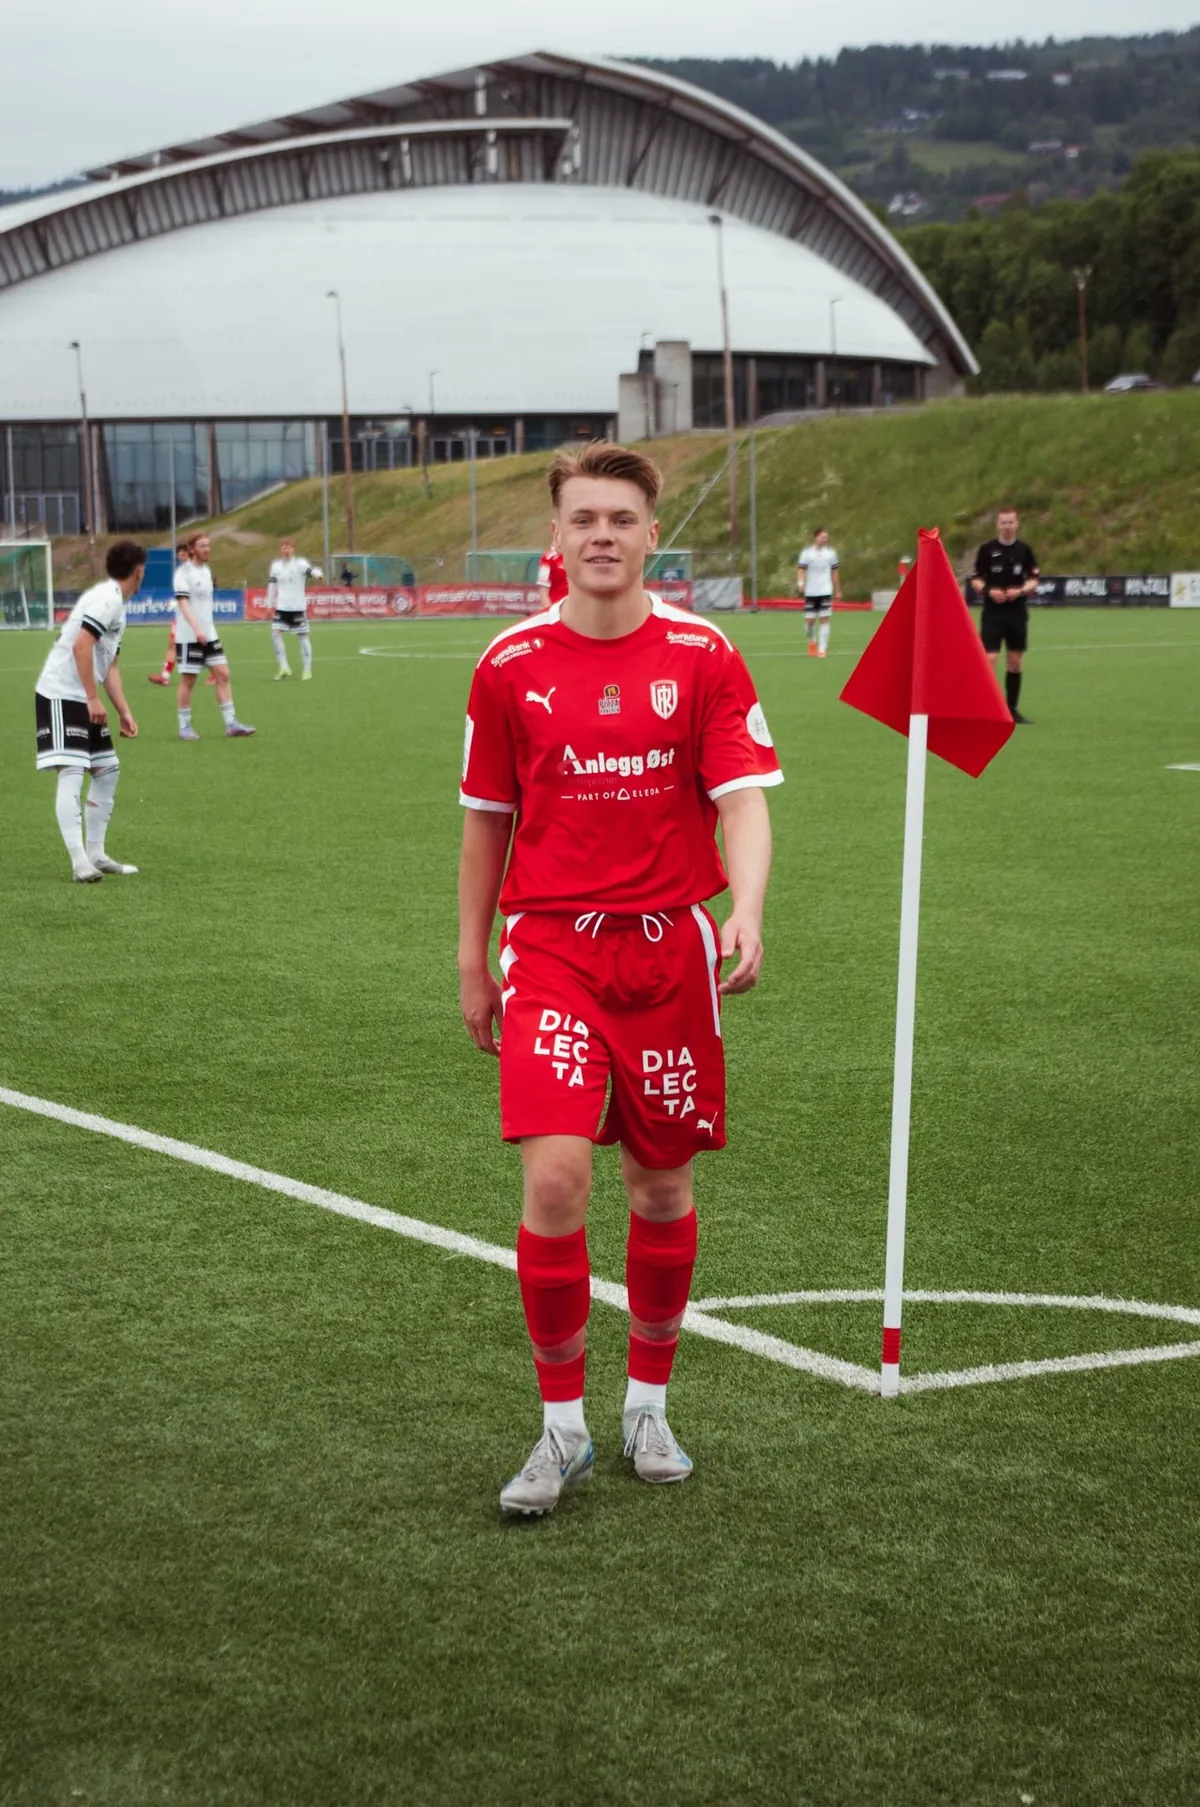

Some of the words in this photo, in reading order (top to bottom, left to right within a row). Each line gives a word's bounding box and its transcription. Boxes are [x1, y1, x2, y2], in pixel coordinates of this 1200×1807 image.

[666, 631, 709, 644] SpareBank
[491, 640, 531, 668] SpareBank
[562, 744, 645, 777] Anlegg
[646, 748, 675, 769] Øst
[577, 793, 599, 801] PART
[602, 791, 615, 800] OF
[632, 787, 660, 798] ELEDA
[538, 1009, 590, 1041] DIA
[533, 1033, 590, 1065] LEC
[641, 1046, 695, 1073] DIA
[551, 1061, 585, 1088] TA
[643, 1069, 698, 1095] LEC
[663, 1095, 697, 1119] TA
